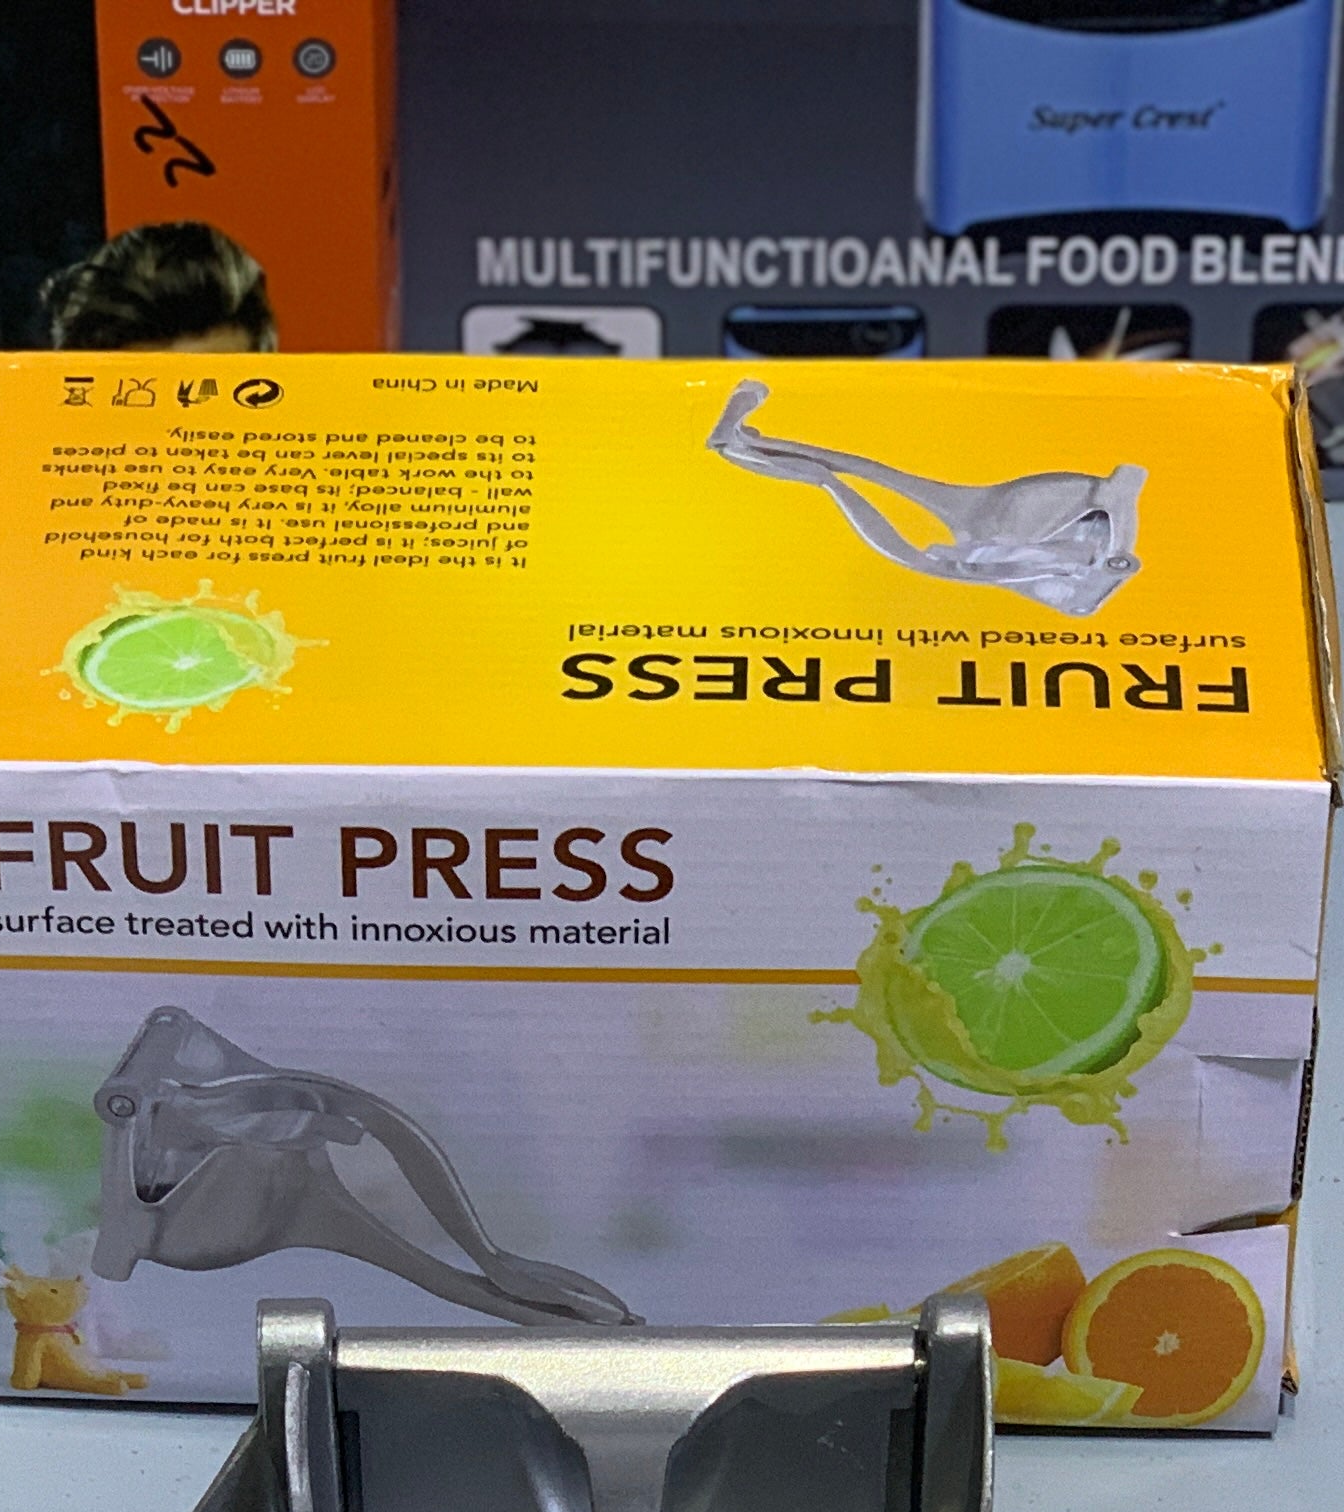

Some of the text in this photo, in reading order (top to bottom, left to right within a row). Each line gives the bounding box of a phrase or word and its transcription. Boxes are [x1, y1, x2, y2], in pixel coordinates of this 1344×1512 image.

[171, 0, 297, 16] CLIPPER
[477, 237, 1016, 287] MULTIFUNCTIOANAL
[1026, 236, 1179, 286] FOOD
[372, 378, 538, 393] Made in China
[166, 426, 537, 448] to be cleaned and stored easily.
[52, 443, 536, 465] to its special lever can be taken to pieces
[42, 462, 534, 483] to the work table. Very easy to use thanks
[102, 480, 160, 495] fixed
[167, 482, 197, 495] be
[205, 483, 246, 493] can
[253, 484, 308, 498] base
[316, 484, 341, 497] its
[349, 483, 463, 500] balanced;
[487, 487, 533, 501] wall
[49, 497, 94, 511] and
[100, 495, 230, 513] heavy-duty
[237, 497, 288, 511] very
[295, 502, 312, 514] is
[321, 502, 336, 514] it
[410, 504, 531, 518] aluminium
[123, 514, 530, 535] and professional use. It is made of
[44, 531, 529, 552] of juices; it is perfect both for household
[79, 548, 527, 569] It is the ideal fruit press for each kind
[568, 623, 1247, 654] surface treated with innoxious material
[560, 652, 1250, 714] FRUIT PRESS
[339, 826, 674, 903] PRESS
[124, 910, 254, 939] treated
[264, 912, 338, 941] with
[351, 914, 517, 944] innoxious
[529, 916, 670, 945] material
